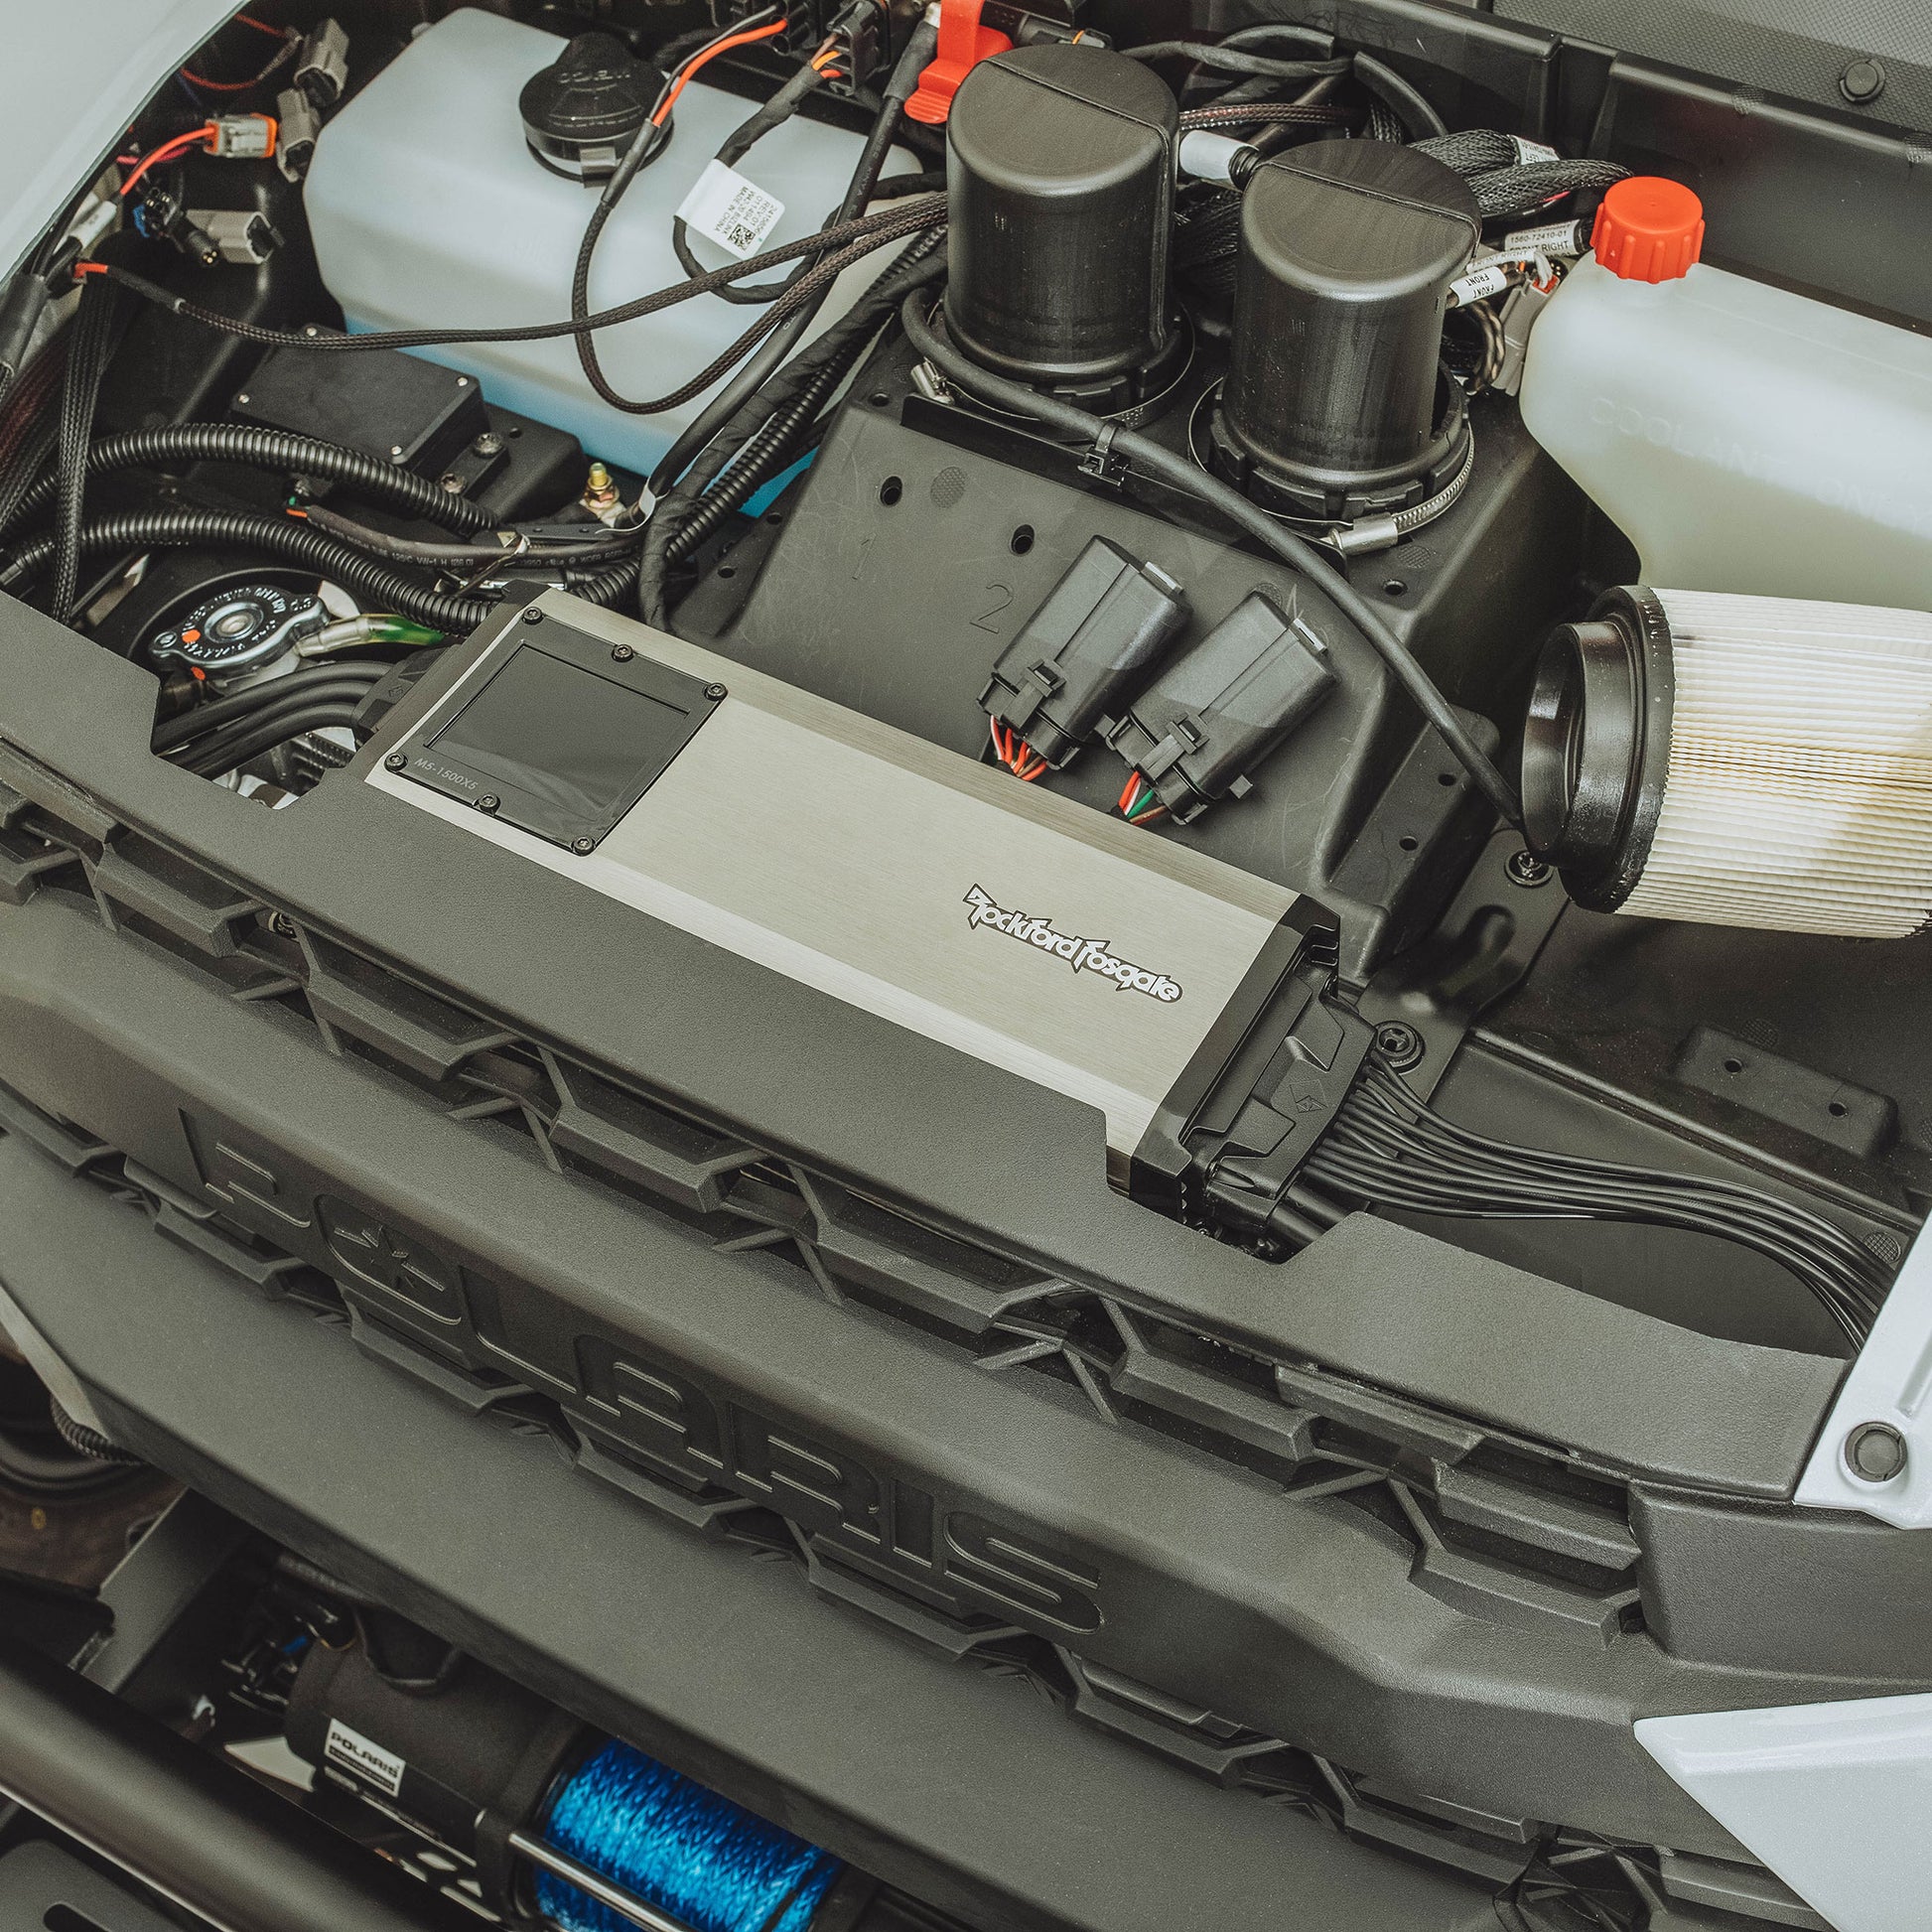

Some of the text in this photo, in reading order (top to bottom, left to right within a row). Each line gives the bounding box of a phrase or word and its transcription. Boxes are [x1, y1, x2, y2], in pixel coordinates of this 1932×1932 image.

[733, 187, 748, 205] MADE
[715, 211, 731, 231] CHINA
[1541, 240, 1569, 253] RIGHT
[1465, 273, 1490, 287] FRONT
[1588, 395, 1789, 484] COOLANT
[969, 583, 1015, 635] 2
[414, 758, 479, 790] M5-1500X5
[962, 883, 1184, 1004] Rockford Fosgate
[177, 1106, 1106, 1636] POLARIS
[331, 1730, 399, 1779] POLARIS
